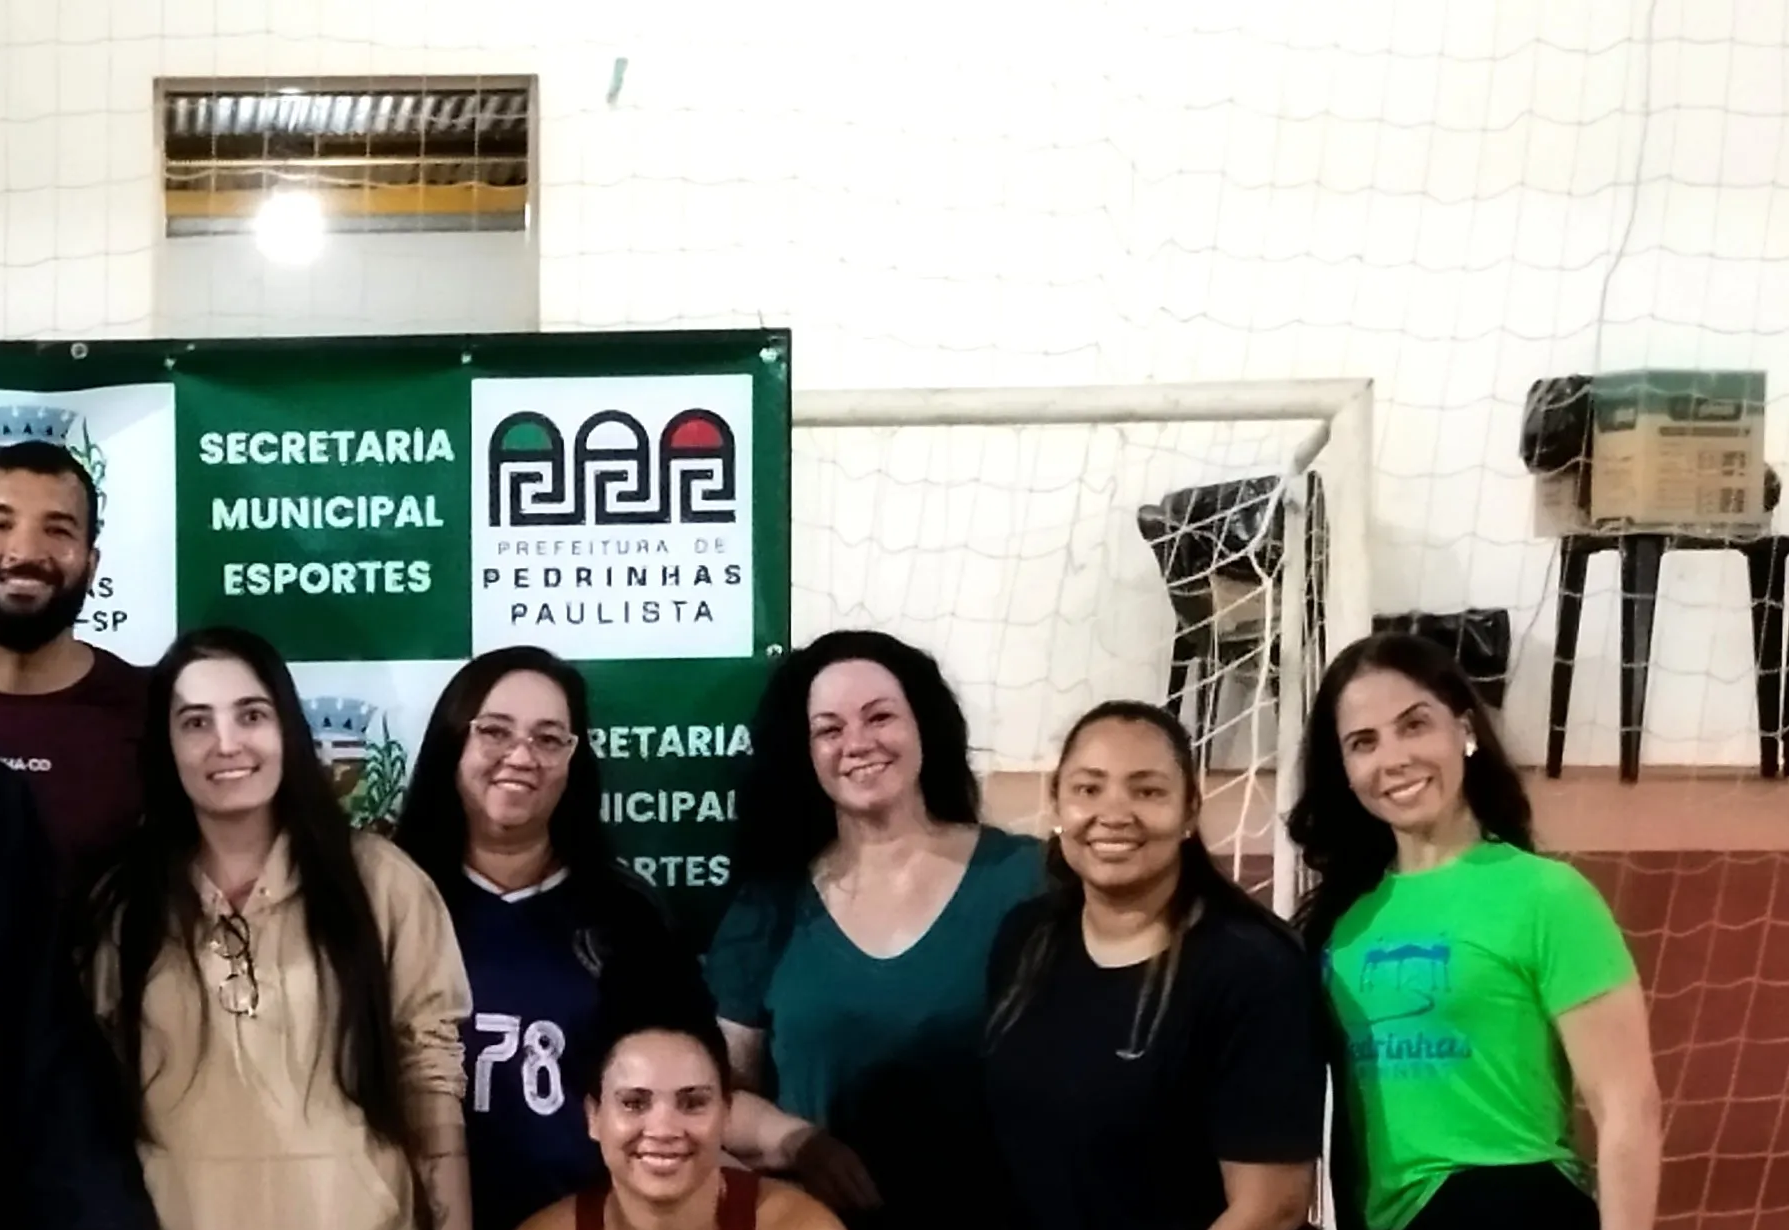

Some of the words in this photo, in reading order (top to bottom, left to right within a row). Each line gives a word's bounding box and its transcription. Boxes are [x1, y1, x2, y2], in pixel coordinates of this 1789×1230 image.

[199, 428, 455, 464] SECRETARIA
[211, 496, 444, 530] MUNICIPAL
[498, 540, 669, 555] PREFEITURA
[694, 538, 727, 553] DE
[223, 561, 432, 595] ESPORTES
[483, 565, 741, 588] PEDRINHAS
[510, 600, 713, 625] PAULISTA
[588, 724, 754, 759] RETARIA
[474, 1013, 565, 1115] 78
